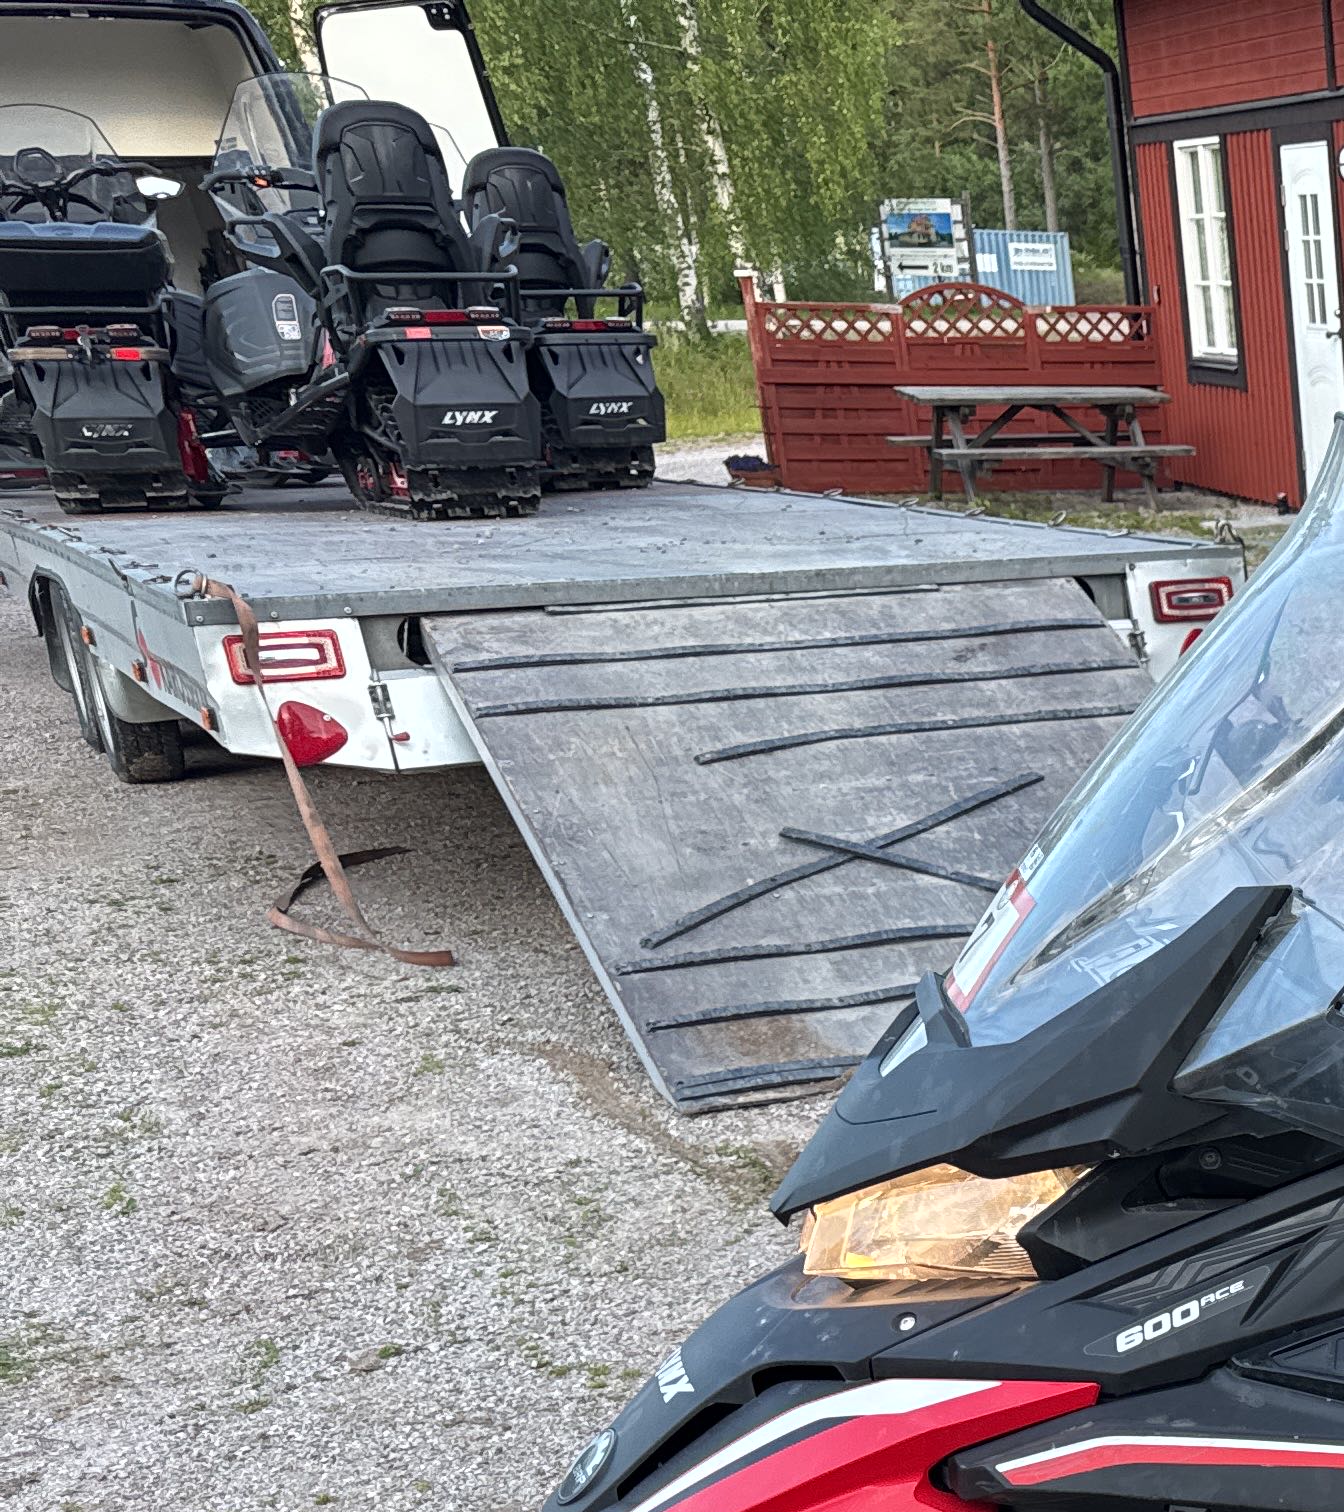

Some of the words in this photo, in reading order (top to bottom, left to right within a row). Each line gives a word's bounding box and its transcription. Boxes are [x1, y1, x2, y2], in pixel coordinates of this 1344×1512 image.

[588, 401, 633, 415] LYNX
[441, 410, 499, 426] LYNX
[1116, 1299, 1200, 1353] 600
[1200, 1279, 1245, 1307] ACE
